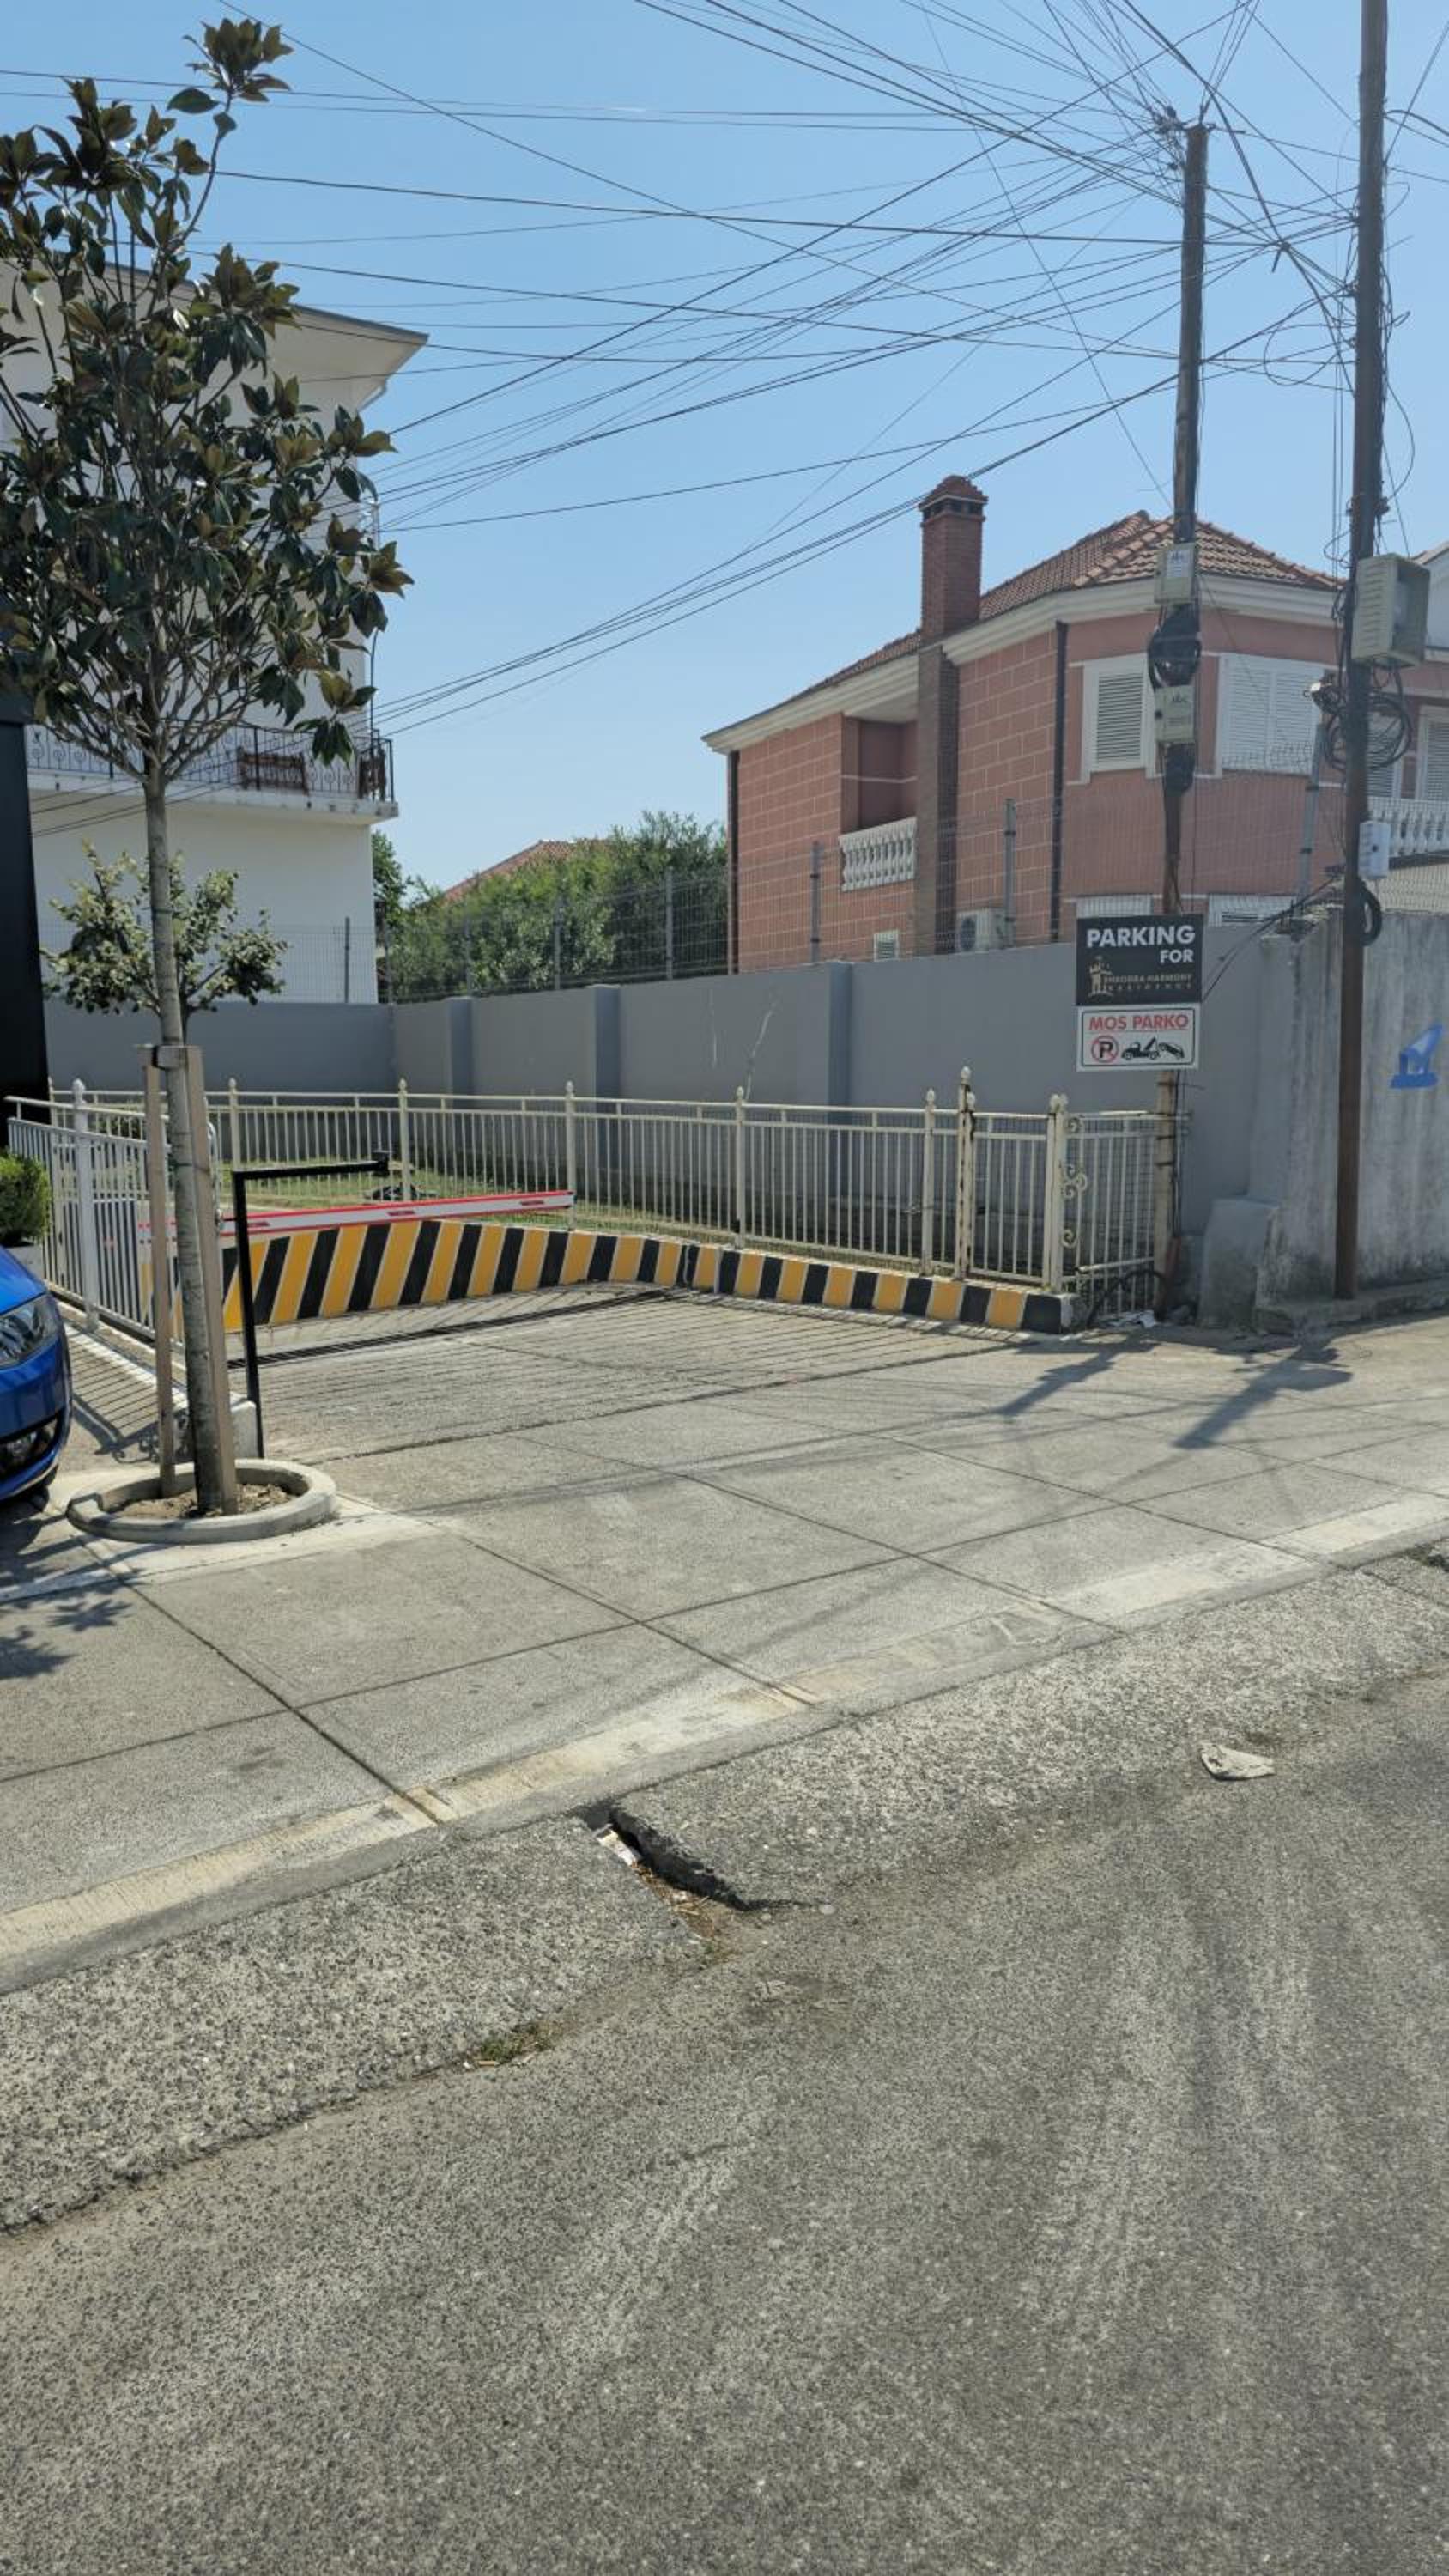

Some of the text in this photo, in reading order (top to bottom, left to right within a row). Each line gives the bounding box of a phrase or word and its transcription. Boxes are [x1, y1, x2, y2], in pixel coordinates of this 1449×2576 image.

[1087, 925, 1196, 948] PARKING
[1160, 949, 1194, 963] FOR
[1089, 1014, 1189, 1030] MOS PARKO
